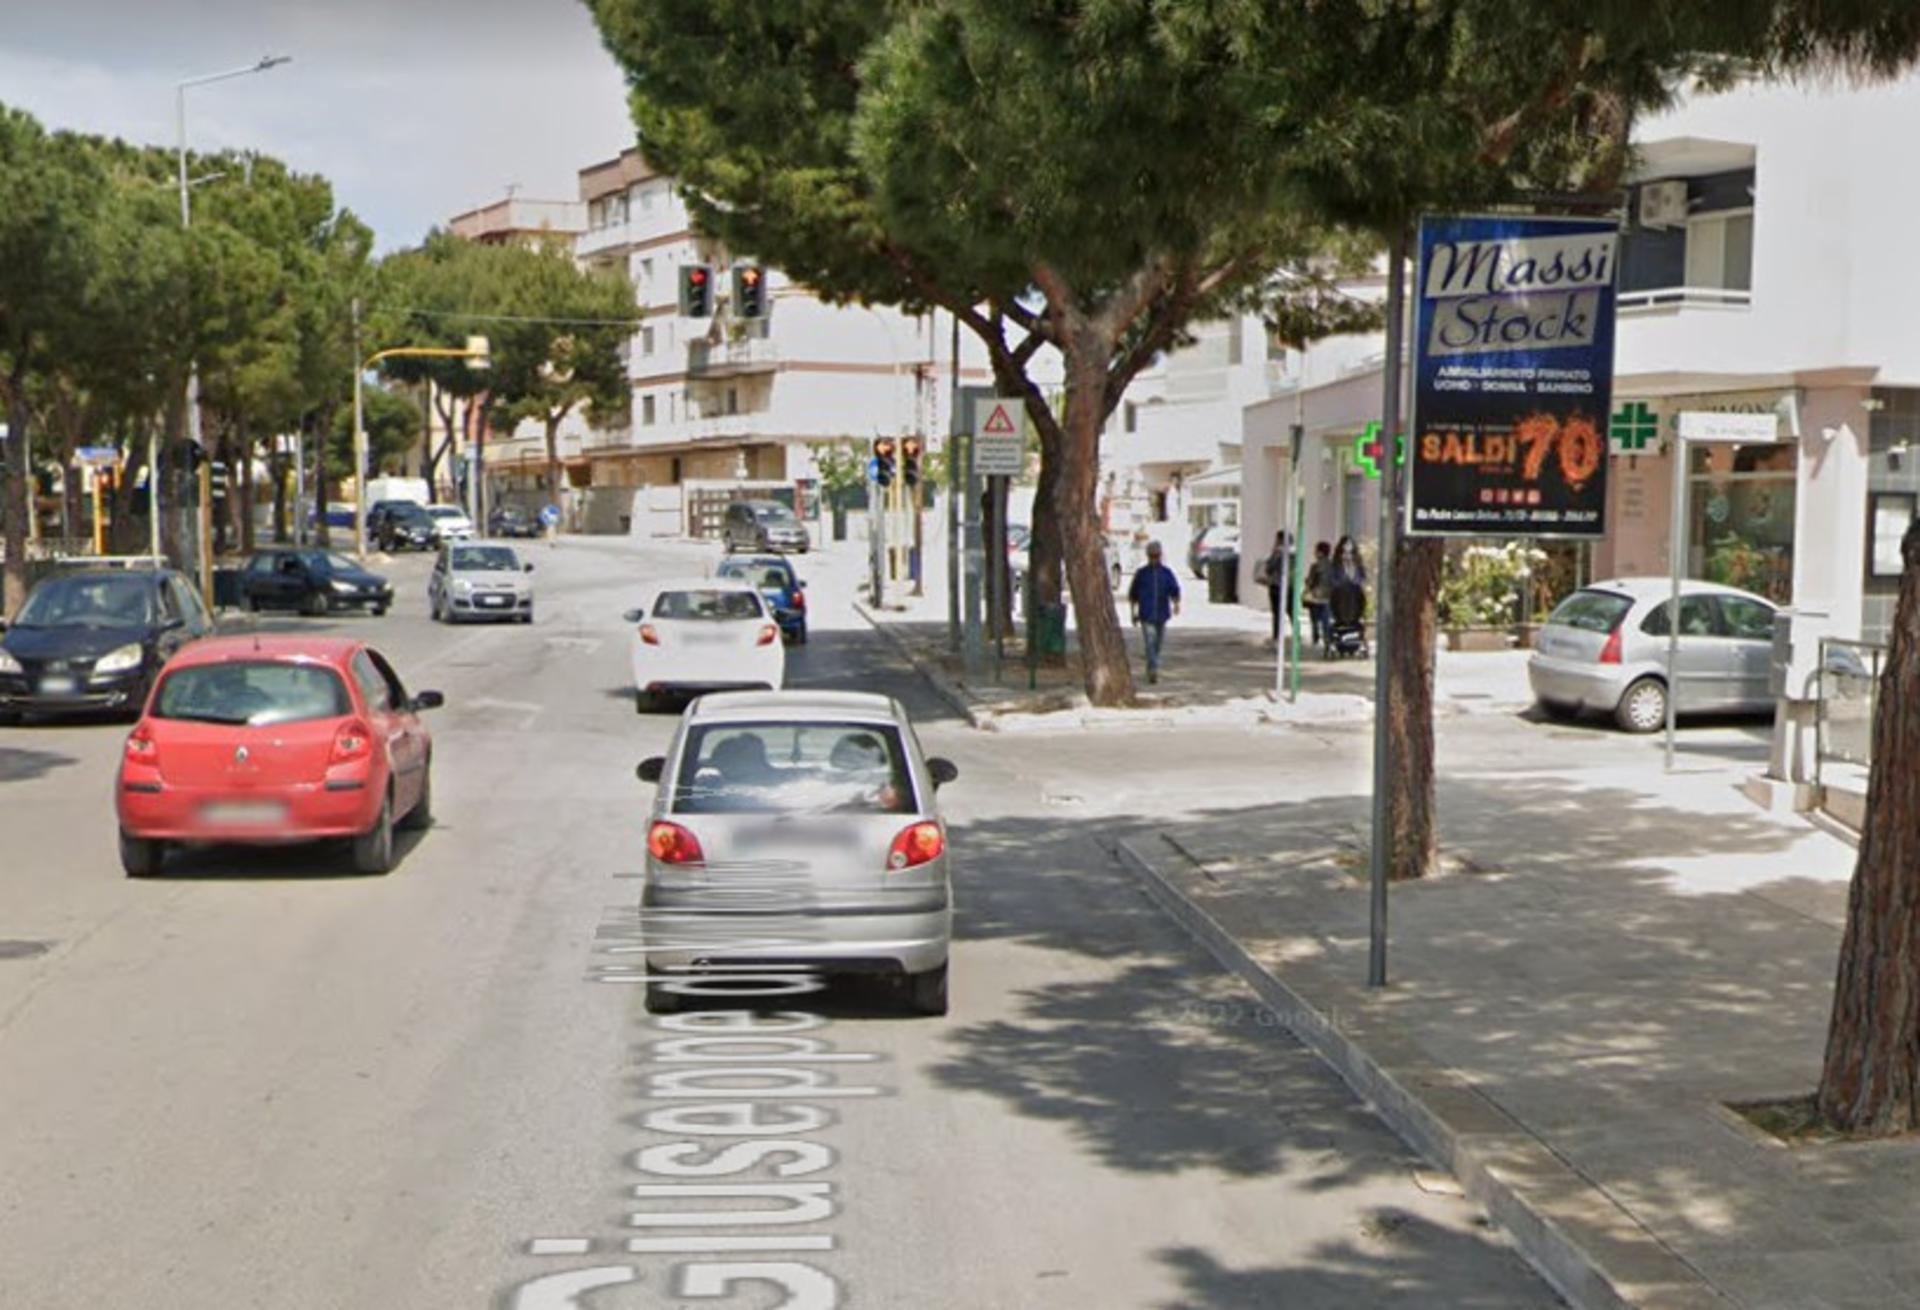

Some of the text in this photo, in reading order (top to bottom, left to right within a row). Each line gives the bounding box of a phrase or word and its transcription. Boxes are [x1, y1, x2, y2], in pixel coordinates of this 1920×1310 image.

[1440, 243, 1609, 294] Massi
[1439, 294, 1586, 347] Stock
[1433, 379, 1471, 391] UOMO
[1537, 382, 1592, 393] BAMBINO
[1421, 411, 1602, 486] SALDI 70
